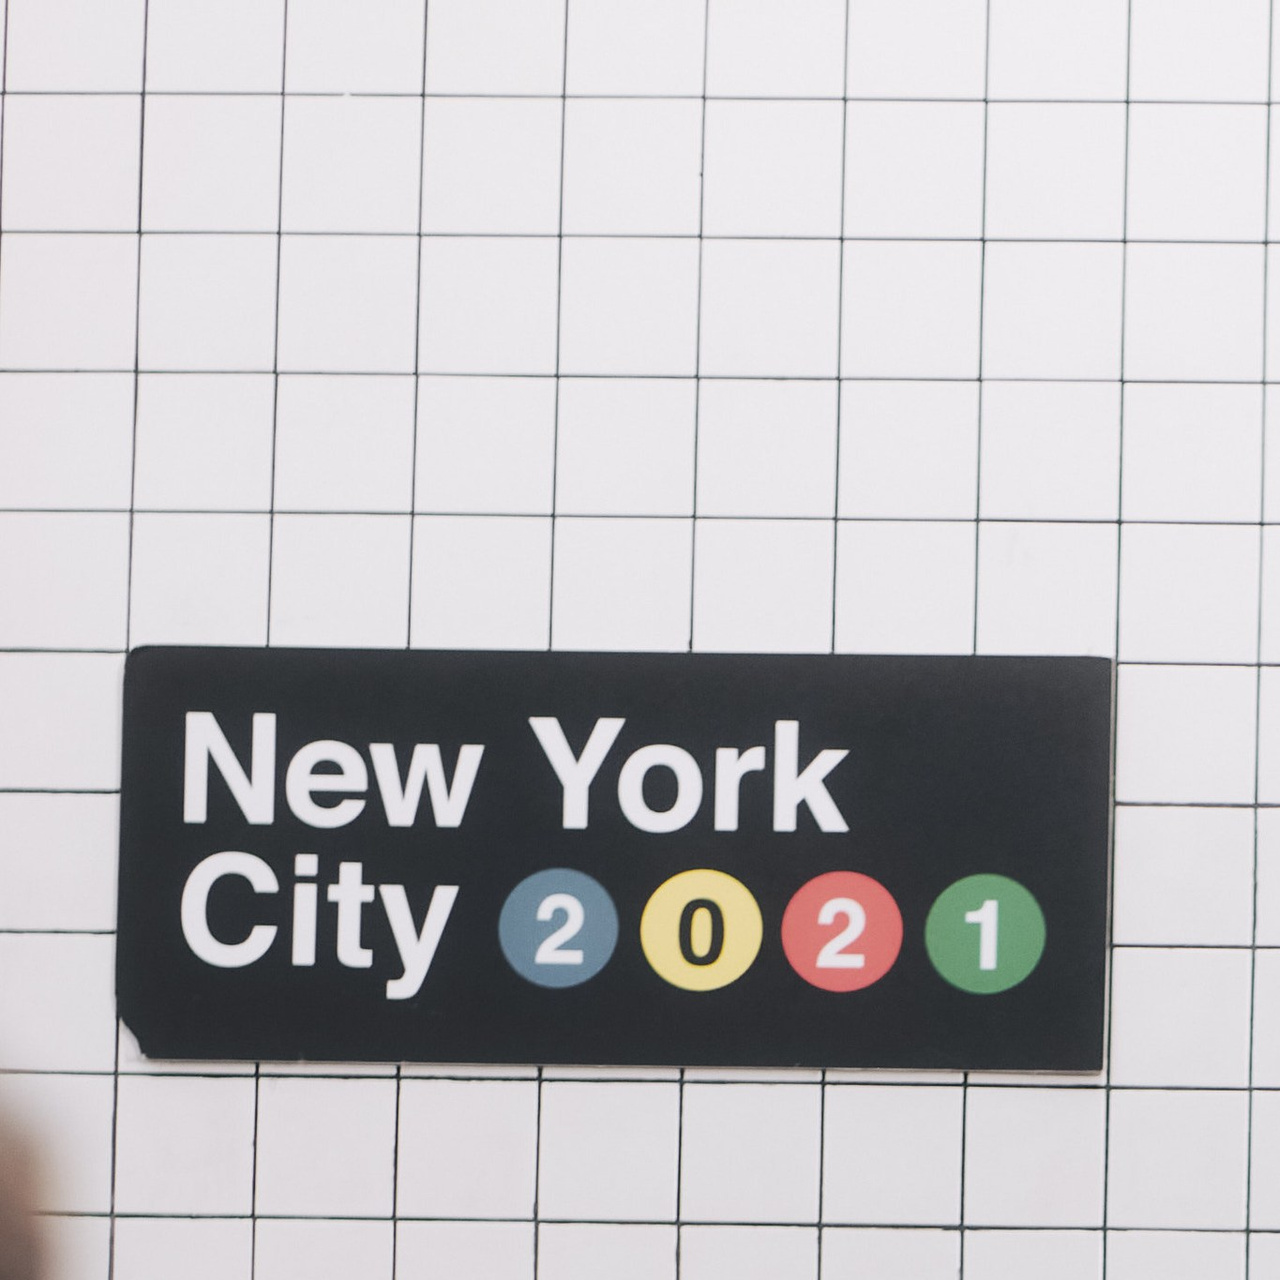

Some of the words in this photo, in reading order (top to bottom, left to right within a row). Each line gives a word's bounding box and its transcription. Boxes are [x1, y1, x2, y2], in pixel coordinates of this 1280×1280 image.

[183, 711, 485, 829] New
[528, 716, 850, 833] York
[180, 851, 459, 1000] City
